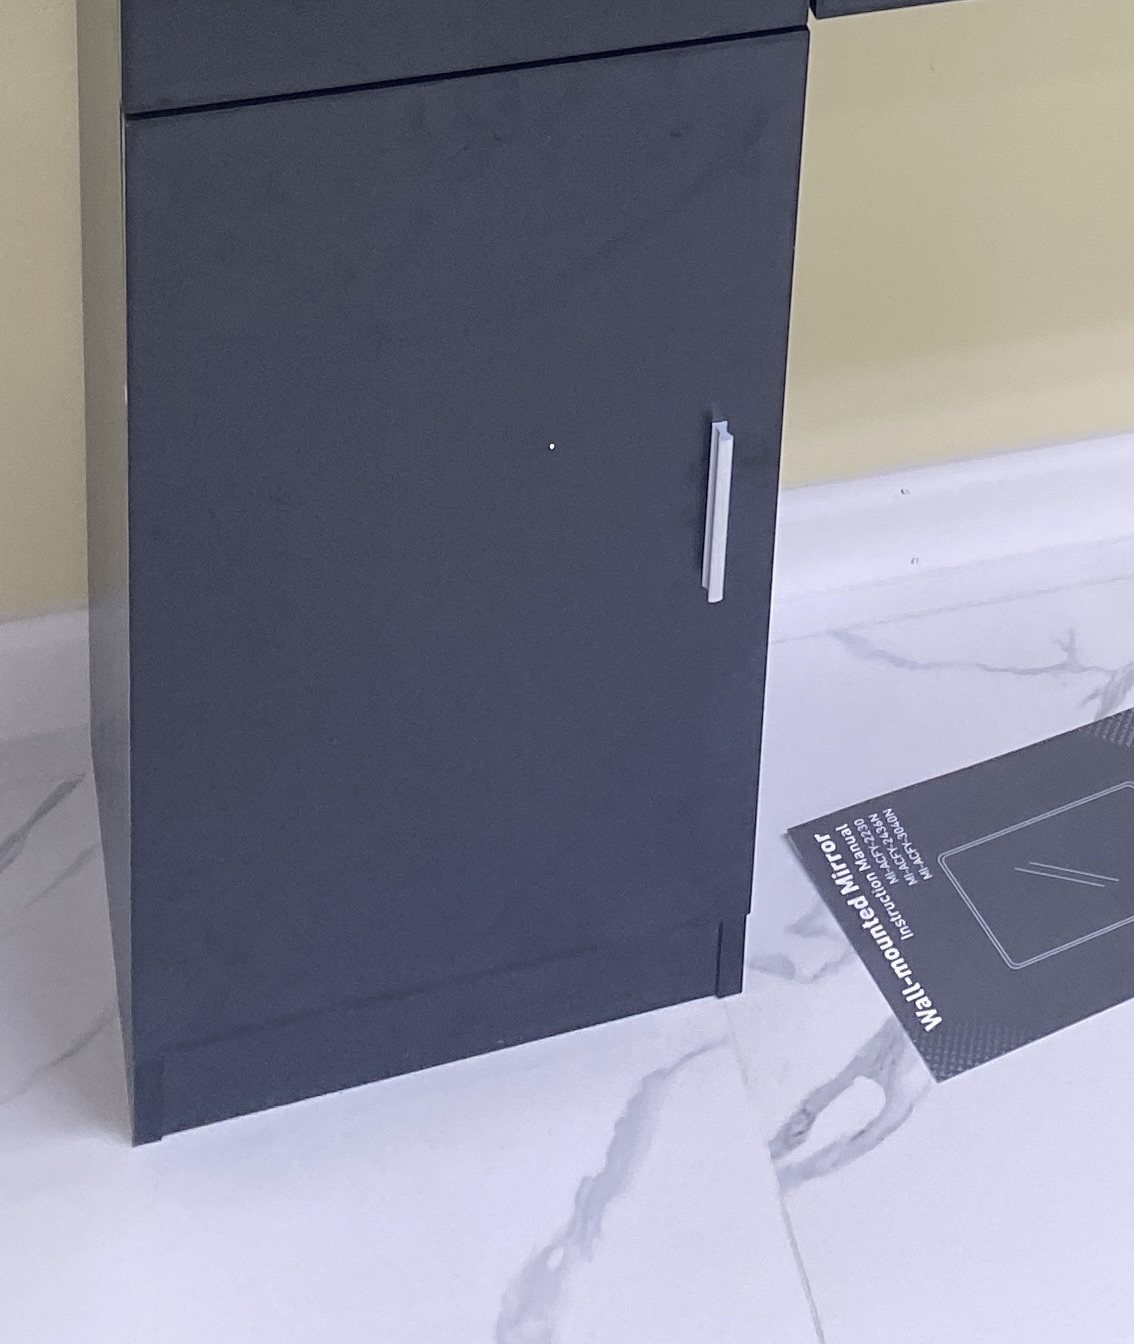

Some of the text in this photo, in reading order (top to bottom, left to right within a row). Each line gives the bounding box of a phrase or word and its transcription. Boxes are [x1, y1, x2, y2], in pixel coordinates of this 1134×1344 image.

[854, 819, 899, 884] MI-ACFY-2230
[868, 814, 918, 885] MI-ACFY-2436N
[883, 809, 932, 879] MI-ACFY-3040N
[836, 824, 913, 940] Instruction Manual
[814, 834, 942, 1031] Wall-mounted Mirror
